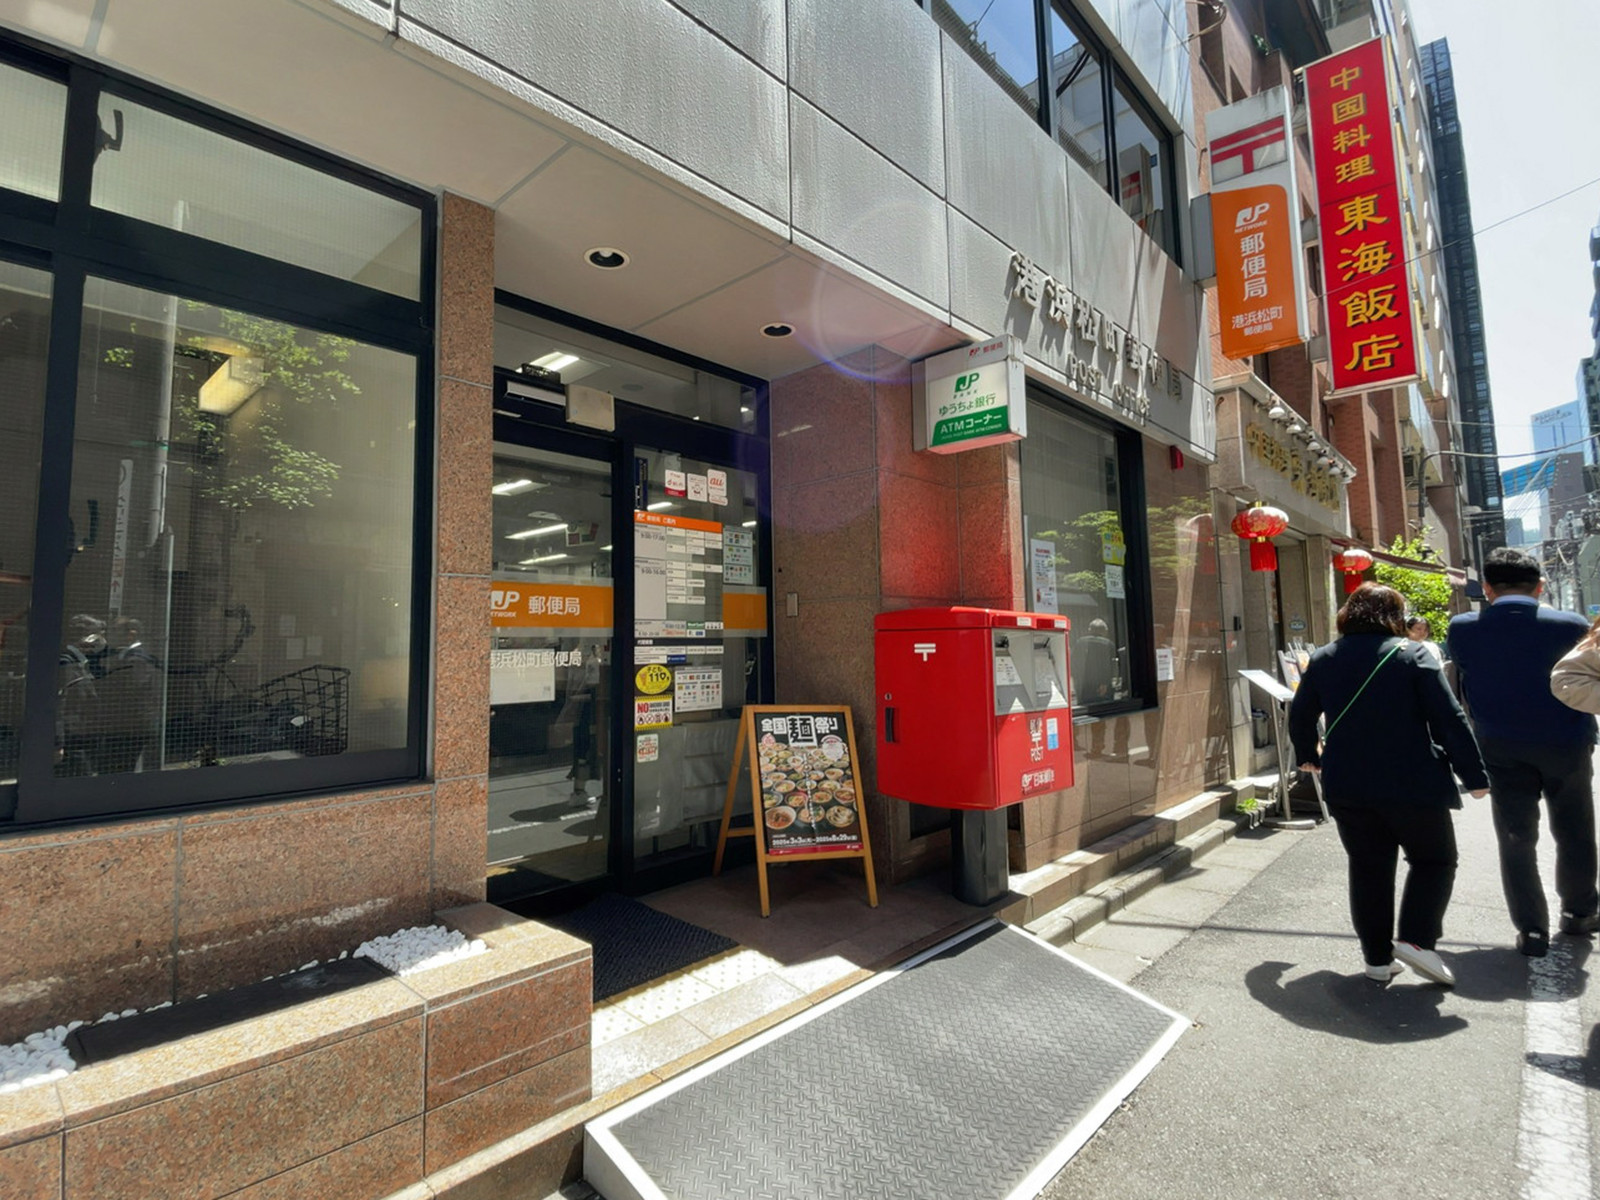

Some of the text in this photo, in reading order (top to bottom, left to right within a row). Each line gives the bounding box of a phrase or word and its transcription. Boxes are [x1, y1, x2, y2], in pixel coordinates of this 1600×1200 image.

[1330, 66, 1376, 184] 中国料理
[1234, 220, 1268, 233] NETWORK
[1240, 232, 1268, 301] 郵便局
[1335, 193, 1403, 373] 東海飯店
[1232, 306, 1283, 330] 港浜松町
[1244, 322, 1273, 336] 郵便局
[1068, 353, 1104, 387] POST
[938, 393, 996, 416] ゆうちょ銀行
[940, 413, 1002, 434] ATMコーナー
[709, 477, 724, 487] au
[528, 596, 581, 616] 郵便局
[637, 703, 649, 713] NO
